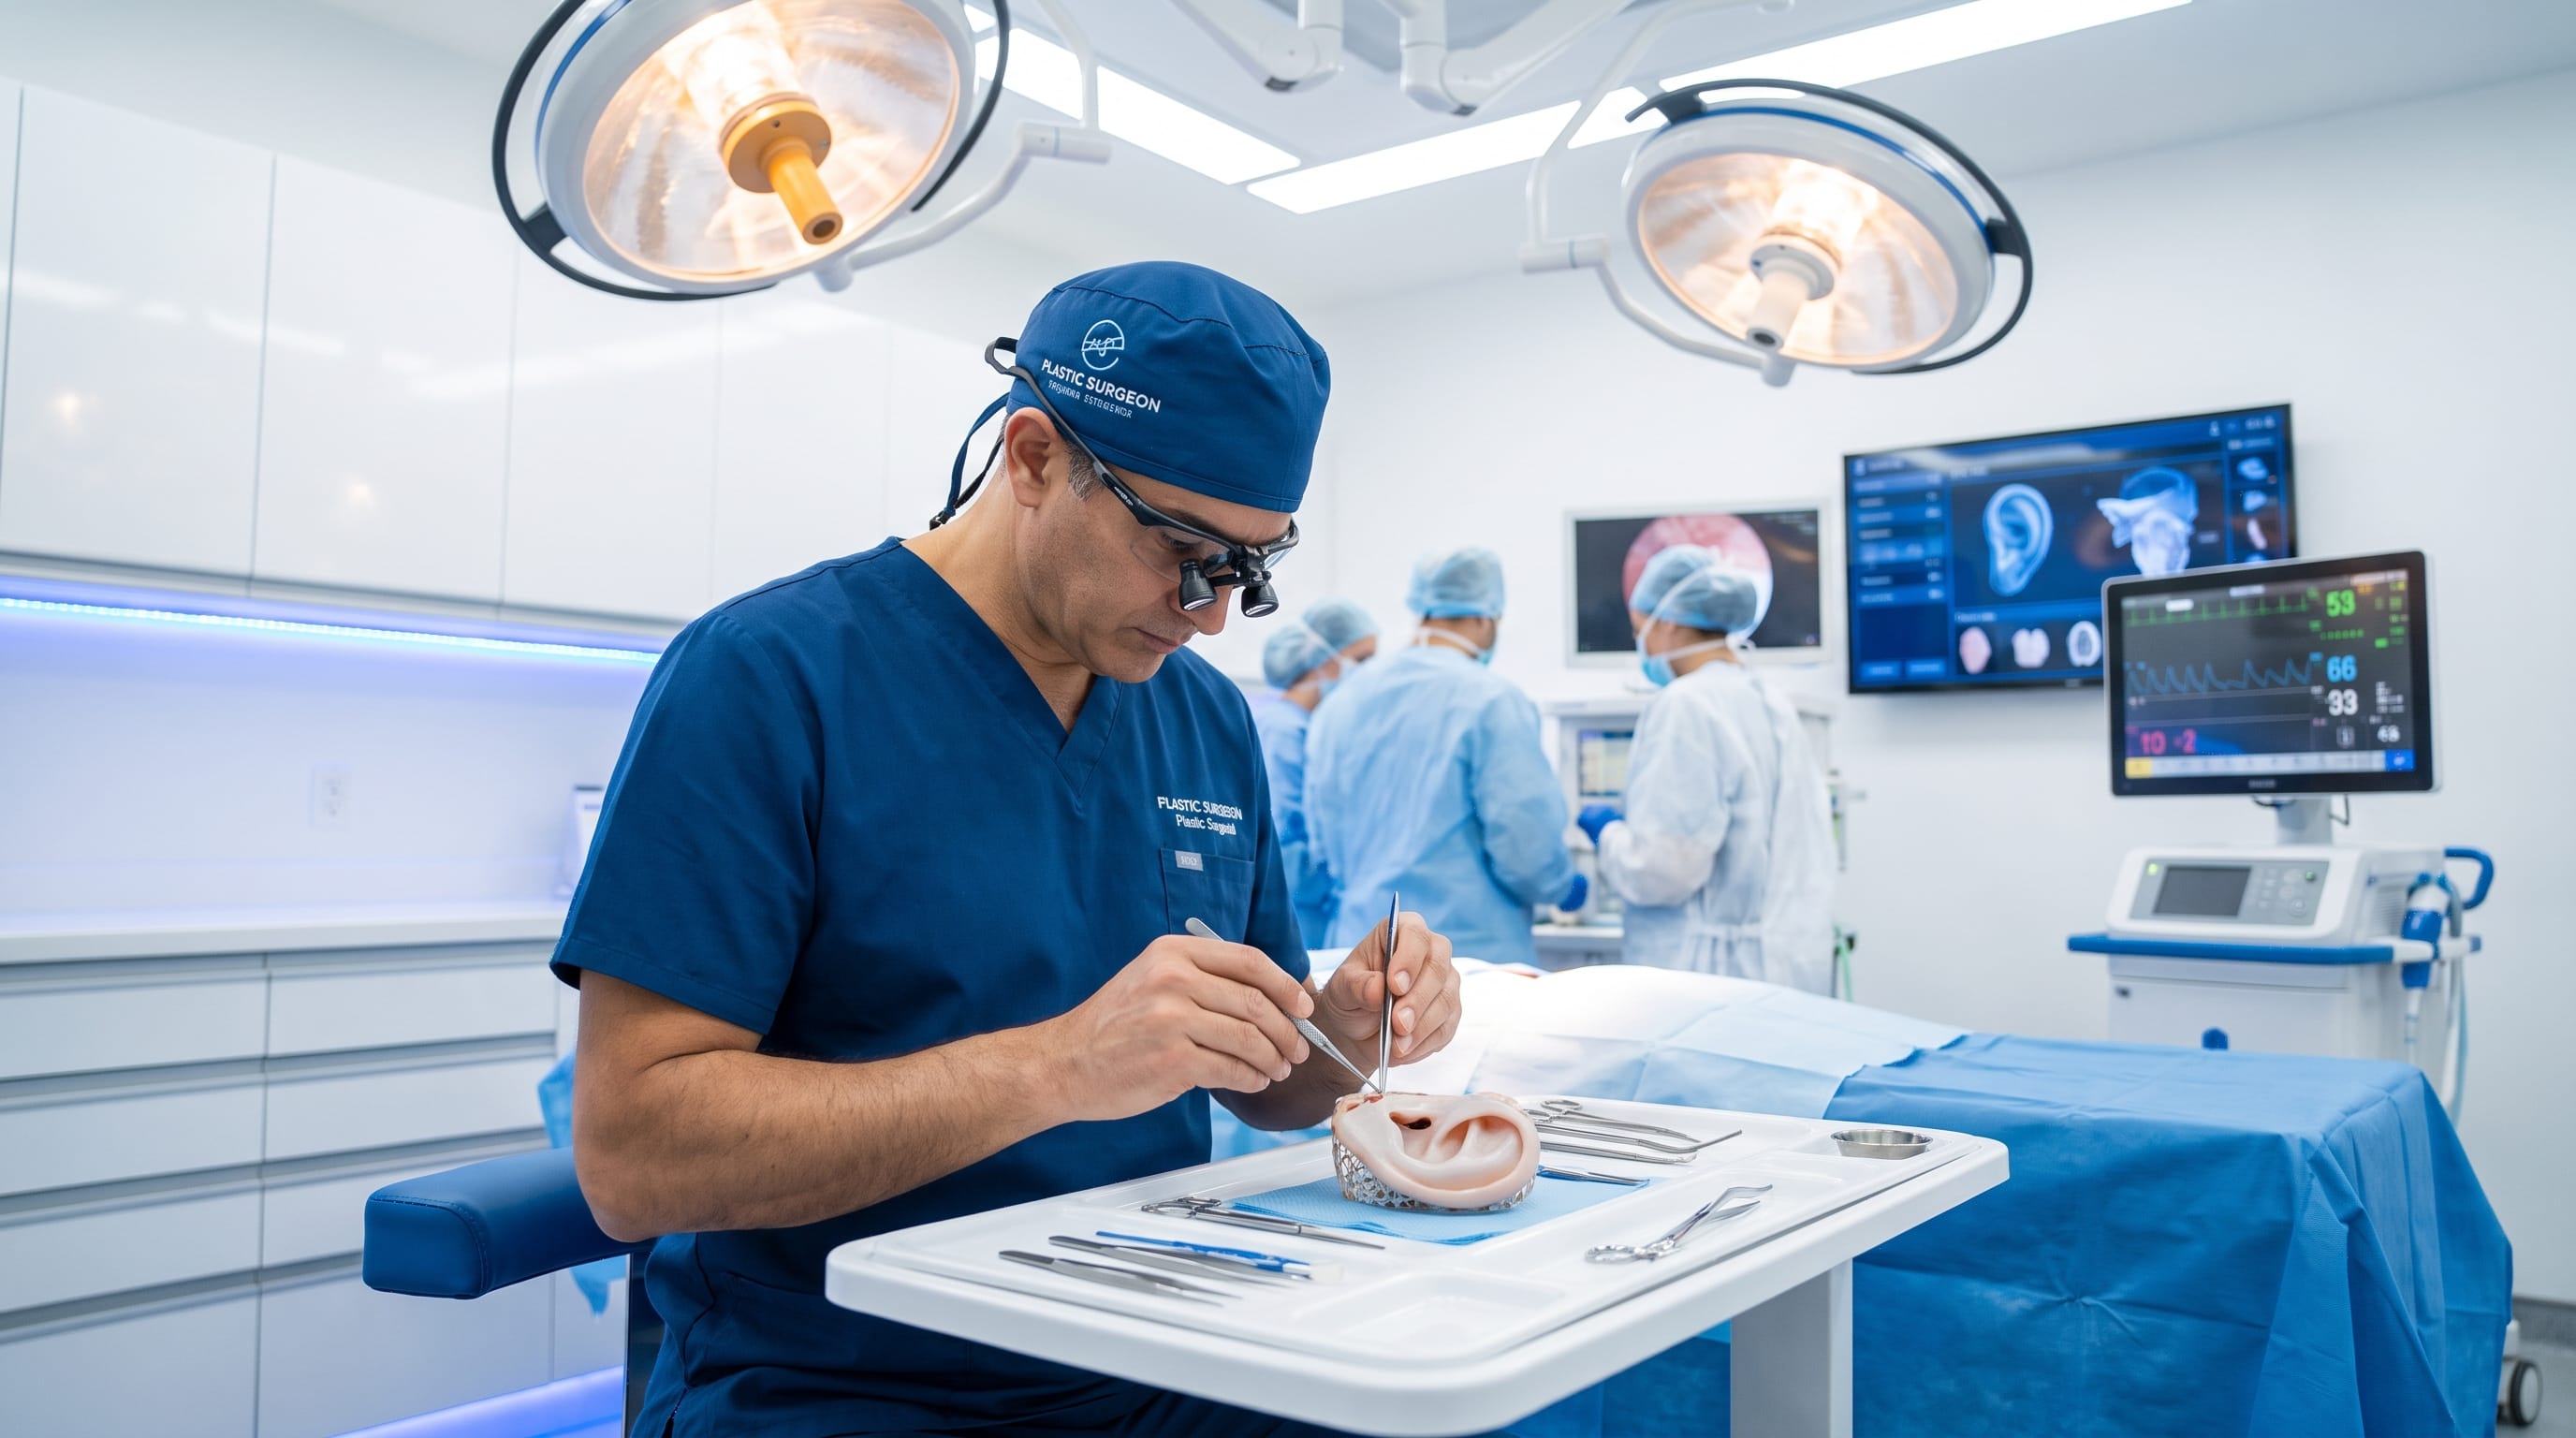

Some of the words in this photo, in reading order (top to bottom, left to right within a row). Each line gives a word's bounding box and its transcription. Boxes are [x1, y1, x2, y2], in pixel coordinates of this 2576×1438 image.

[1041, 359, 1085, 387] PLASTIC
[1085, 376, 1161, 413] SURGEON
[2326, 590, 2356, 617] 53
[2327, 655, 2358, 683] 66
[2329, 689, 2359, 716] 33
